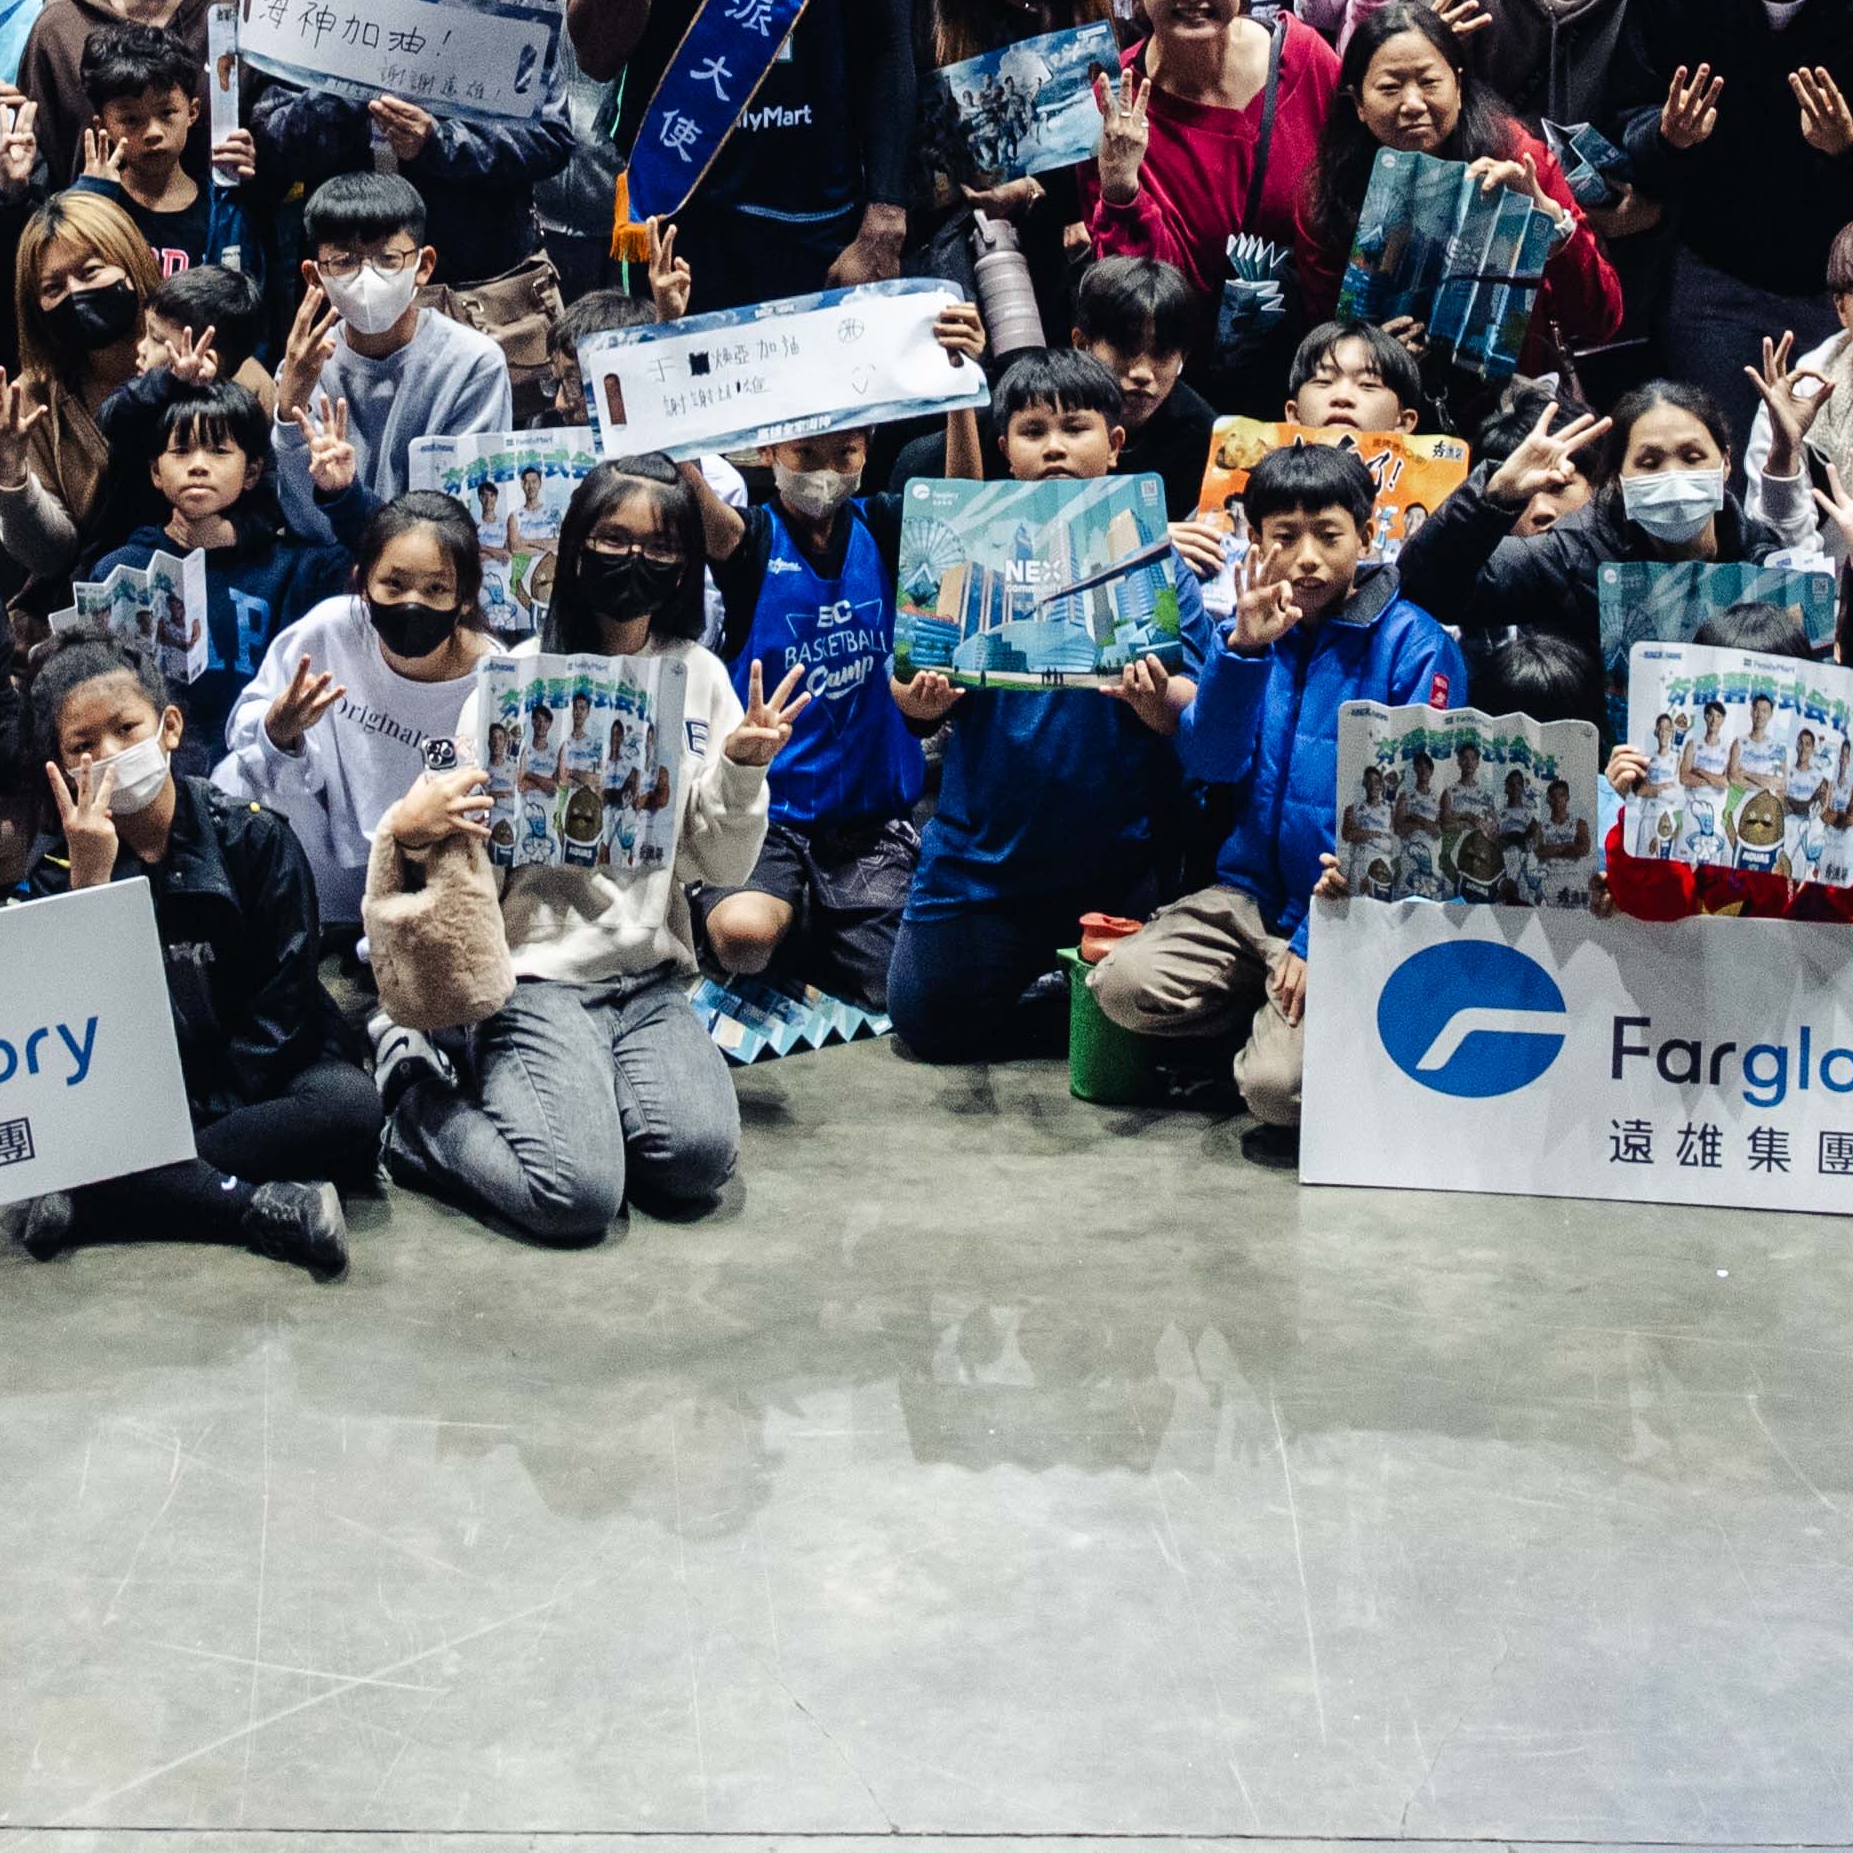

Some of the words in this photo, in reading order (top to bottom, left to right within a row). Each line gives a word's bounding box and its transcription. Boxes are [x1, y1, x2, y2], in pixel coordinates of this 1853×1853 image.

[739, 102, 813, 129] lyMart
[1004, 559, 1062, 583] NEX
[1004, 583, 1063, 596] community
[783, 630, 889, 670] BASKETBALL
[806, 655, 875, 702] Camp
[1753, 661, 1797, 675] FamilyMart
